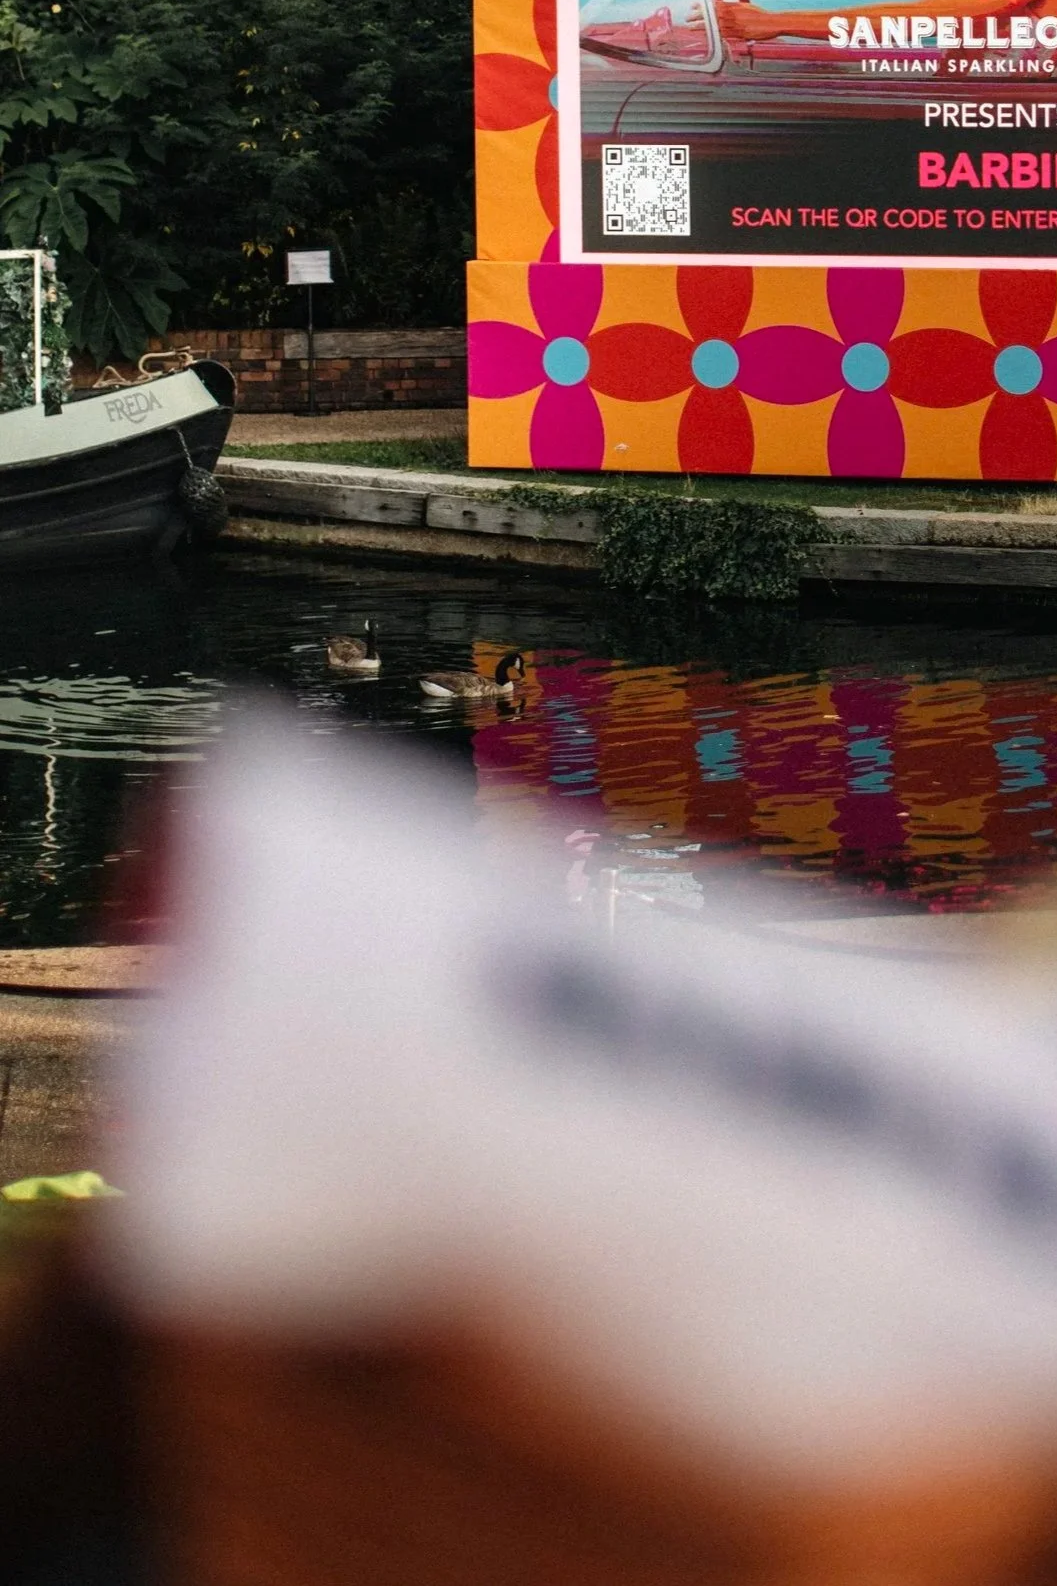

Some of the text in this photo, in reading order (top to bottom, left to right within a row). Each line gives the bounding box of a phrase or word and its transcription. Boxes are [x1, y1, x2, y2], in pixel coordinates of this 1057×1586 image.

[861, 59, 938, 74] ITALIAN
[947, 59, 1055, 74] SPARKLING
[731, 207, 792, 228] SCAN
[797, 207, 840, 228] THE
[845, 208, 878, 229] QR
[883, 208, 948, 229] CODE
[953, 209, 986, 229] TO
[103, 389, 163, 424] FREDA
